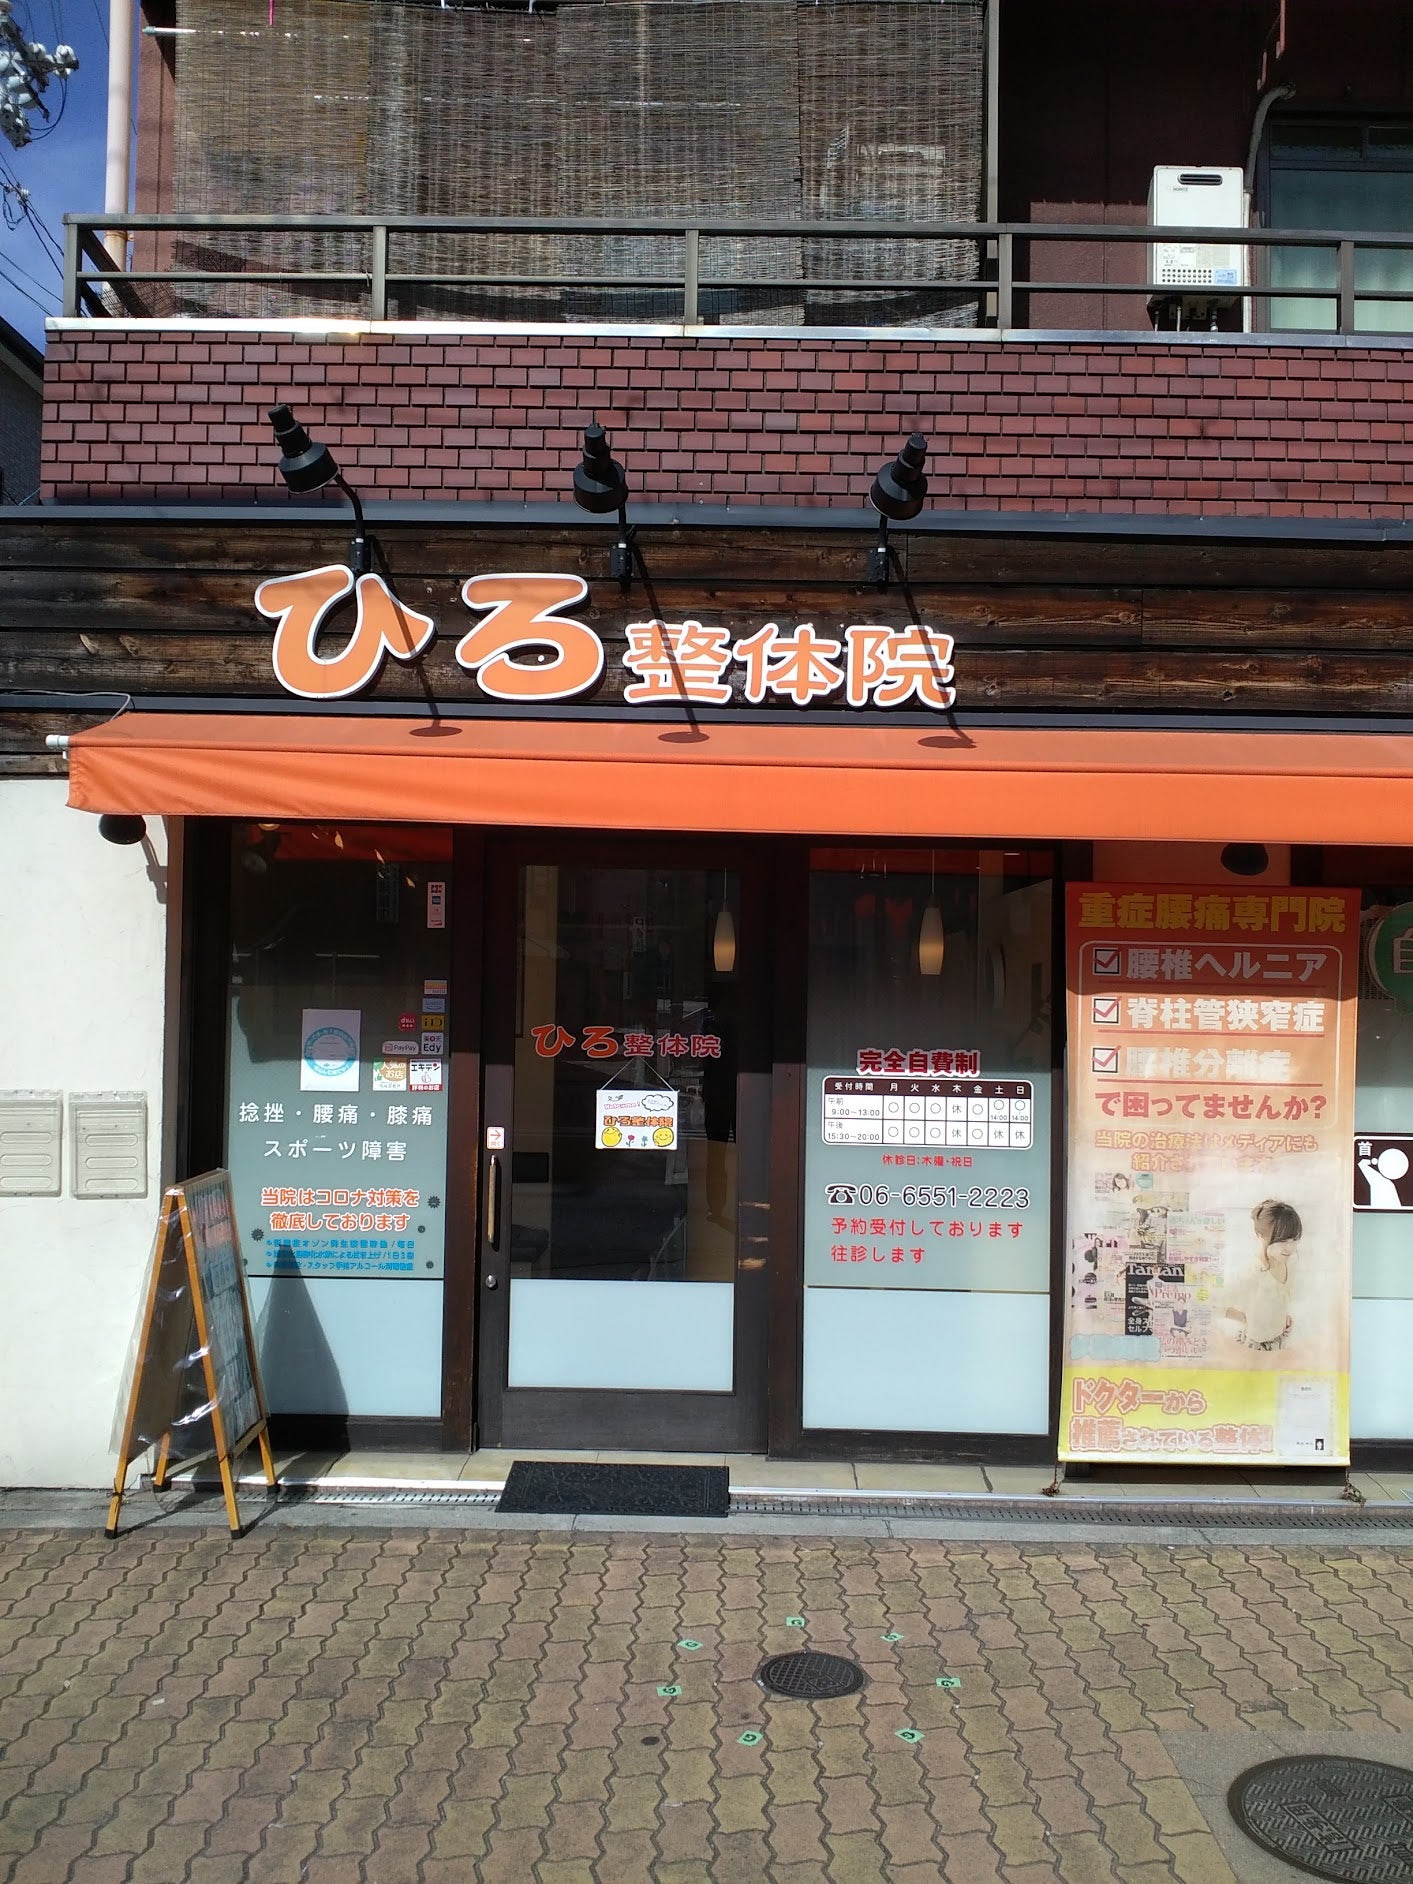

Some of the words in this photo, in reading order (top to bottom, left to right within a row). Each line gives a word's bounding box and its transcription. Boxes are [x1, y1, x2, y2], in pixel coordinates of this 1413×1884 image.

[1078, 892, 1346, 932] 重症腰痛専門院
[1126, 948, 1328, 982] 腰椎ヘルニア
[1127, 997, 1325, 1032] 脊柱管狭窄症
[423, 1043, 441, 1053] Edy
[857, 1049, 980, 1077] 完全自費制
[835, 1082, 874, 1091] 受付時間
[889, 1083, 898, 1092] 月
[910, 1084, 920, 1093] 火
[931, 1084, 940, 1093] 水
[952, 1085, 961, 1094] 木
[973, 1085, 983, 1094] 金
[995, 1086, 1004, 1094] 土
[1016, 1086, 1025, 1095] 日
[239, 1102, 433, 1126] 捻挫・腰痛・膝痛
[952, 1104, 962, 1114] 休
[1095, 1091, 1327, 1120] で困ってませんか?
[952, 1129, 961, 1138] 休
[994, 1130, 1003, 1139] 休
[1015, 1130, 1025, 1140] 休
[264, 1138, 407, 1161] スポーツ障害
[1357, 1141, 1373, 1157] 首
[261, 1187, 420, 1207] 当院はコロナ対策を
[858, 1184, 1030, 1209] 06-6551-2223
[270, 1212, 411, 1232] 徹底しております
[831, 1217, 1023, 1238] 予約受付しております
[831, 1244, 925, 1264] 往診します
[1125, 1262, 1185, 1277] Taran
[1073, 1377, 1207, 1414] ドクターから
